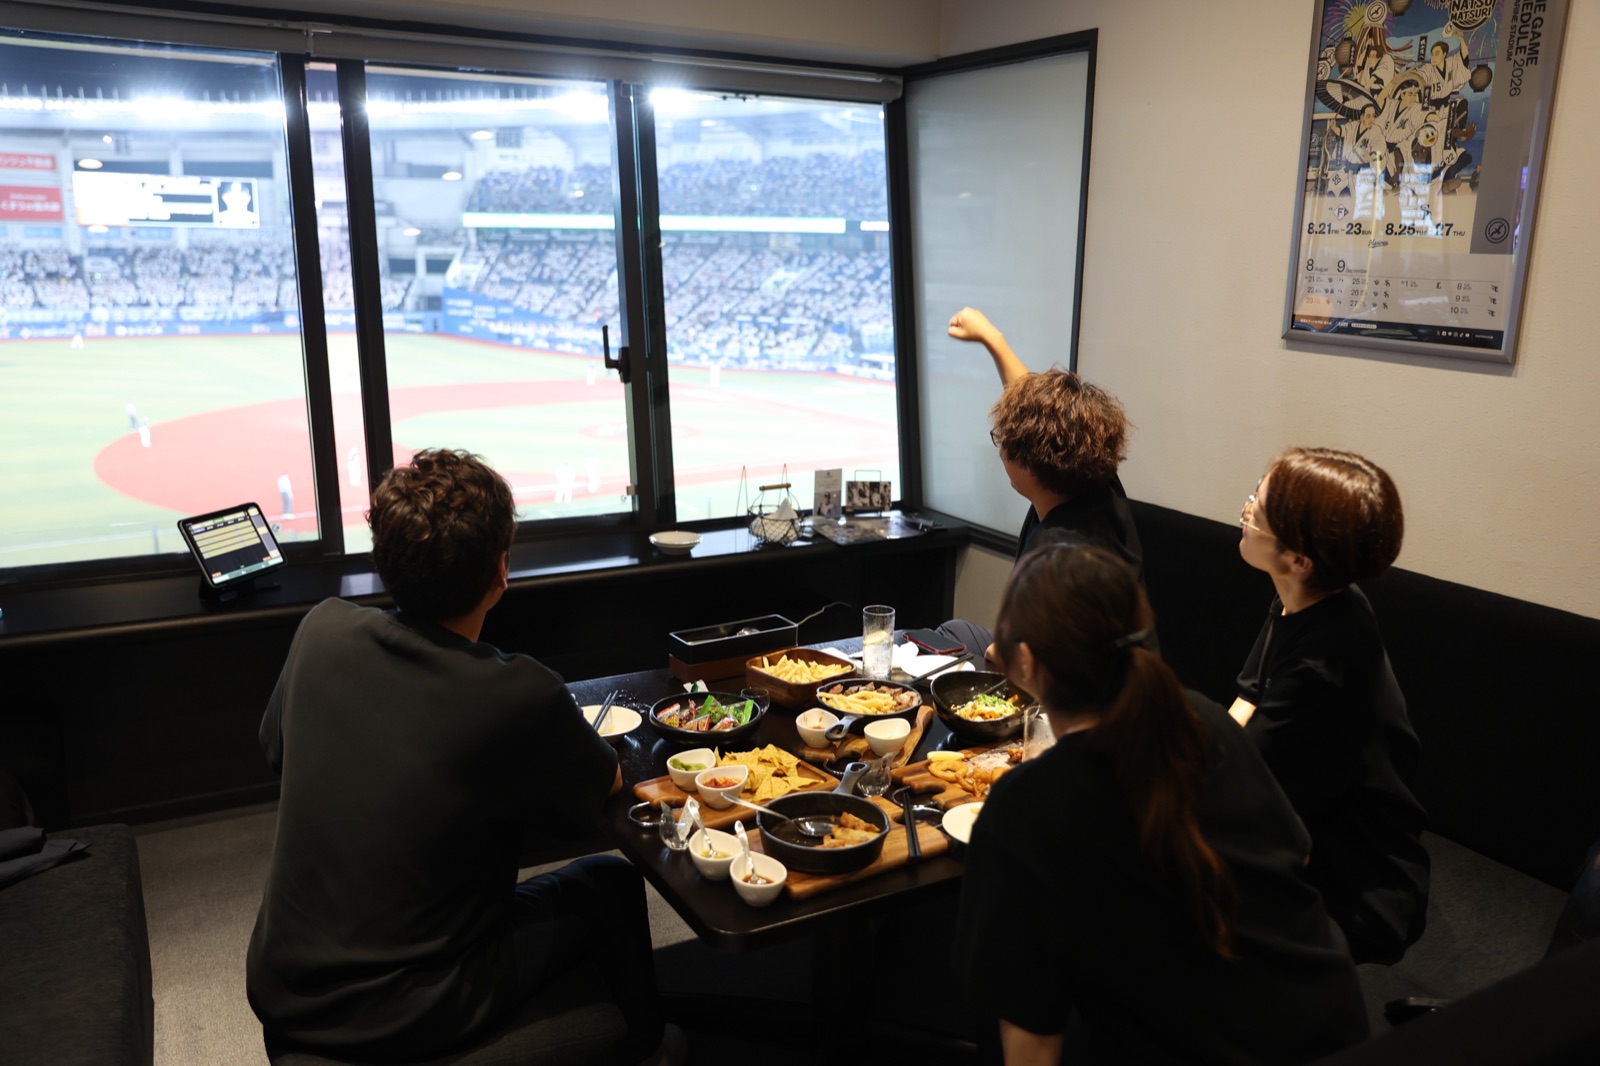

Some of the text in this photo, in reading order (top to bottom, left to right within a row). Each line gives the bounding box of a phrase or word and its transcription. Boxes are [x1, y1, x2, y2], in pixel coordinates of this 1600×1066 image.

[1451, 7, 1491, 21] MATSURI
[1506, 24, 1518, 61] STADIUM
[1526, 17, 1544, 67] GAME
[1509, 59, 1525, 97] 2026
[1432, 82, 1441, 93] 15
[1306, 258, 1314, 272] 8
[1336, 259, 1346, 273] 9
